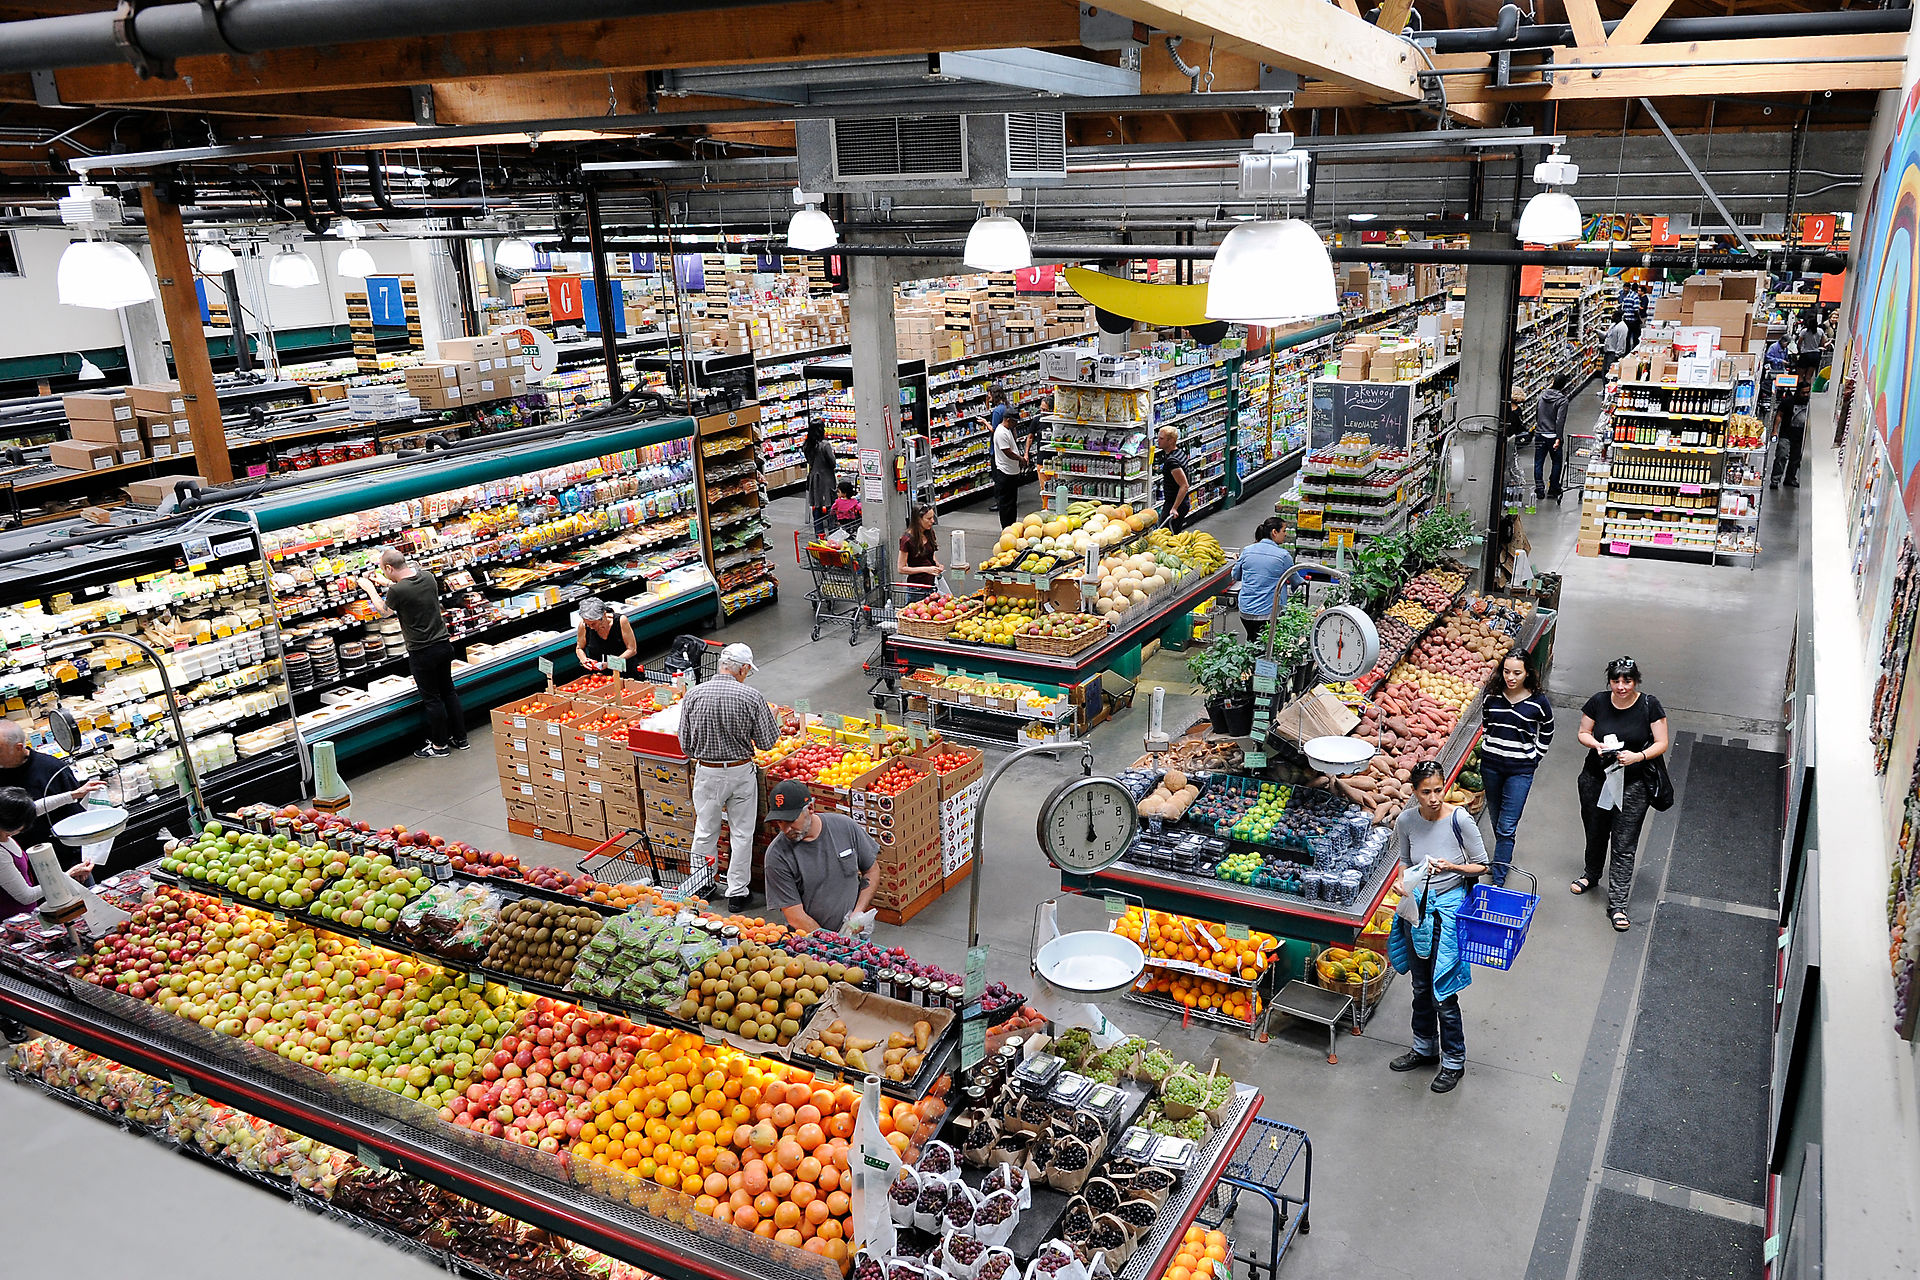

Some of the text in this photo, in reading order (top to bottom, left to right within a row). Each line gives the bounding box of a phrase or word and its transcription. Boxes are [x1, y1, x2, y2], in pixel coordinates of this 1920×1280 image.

[1815, 219, 1824, 241] 2
[682, 255, 692, 283] 7
[379, 286, 390, 320] 7
[560, 282, 573, 314] G
[1344, 415, 1379, 430] LEMONADE
[1103, 794, 1111, 804] 9
[1069, 800, 1074, 810] 1
[1115, 806, 1122, 816] 8
[1058, 817, 1065, 827] 2
[1117, 824, 1124, 835] 7
[1058, 836, 1065, 846] 3
[1104, 841, 1111, 851] 6
[1069, 848, 1075, 858] 4
[1087, 850, 1094, 860] 5
